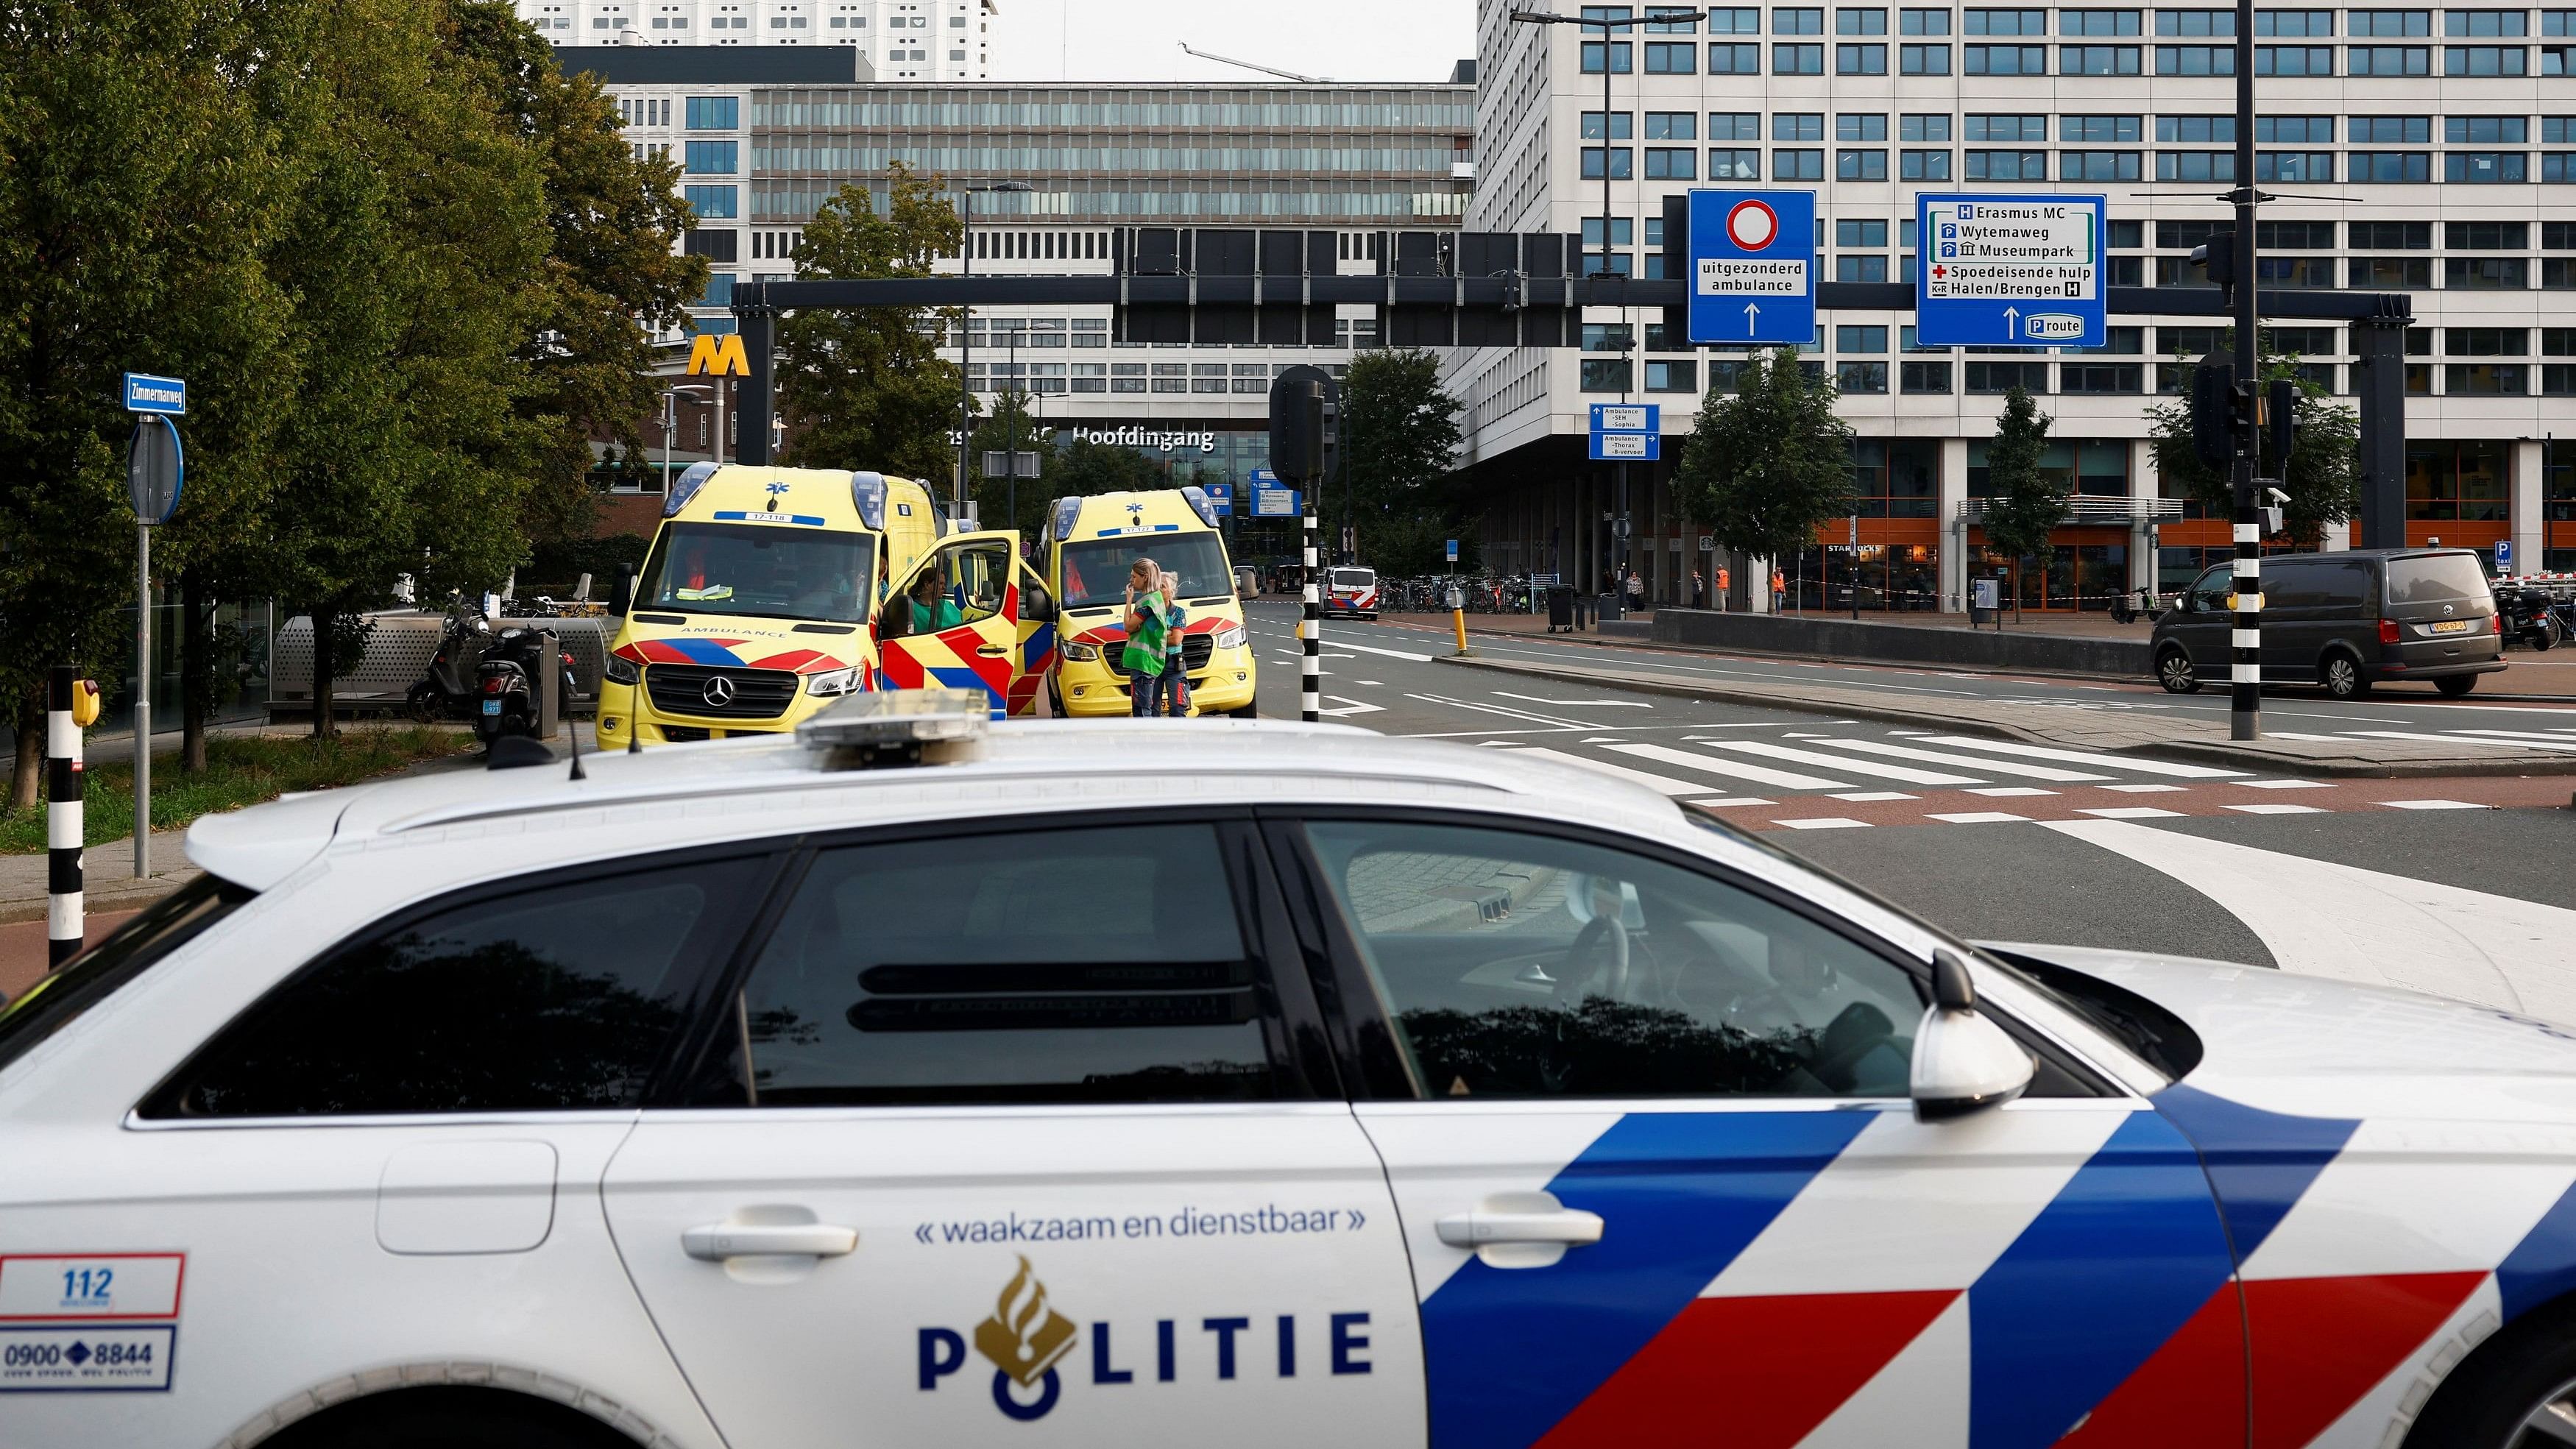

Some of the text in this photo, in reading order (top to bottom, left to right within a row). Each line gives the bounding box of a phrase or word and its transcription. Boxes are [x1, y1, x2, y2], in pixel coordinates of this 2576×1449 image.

[1977, 207, 2038, 219] Erasmus
[2043, 208, 2065, 219] MC
[1961, 226, 2049, 241] Wytemaweg
[1980, 244, 2074, 260] Museumpark
[1703, 262, 1802, 276] uitgezonderd
[1951, 266, 2091, 281] Spoedeisende hulp
[1712, 279, 1793, 291] ambulance
[1951, 282, 2061, 298] Halen/Brengen
[2047, 320, 2079, 331] route
[132, 383, 183, 408] Zimmermanweg
[1072, 425, 1214, 452] Hoofdingang
[681, 628, 788, 639] AMBULANCE
[942, 1212, 1115, 1243] waakzaam
[1123, 1216, 1162, 1238] en
[1170, 1204, 1339, 1237] dienstbaar
[5, 1343, 152, 1366] 0900 8844
